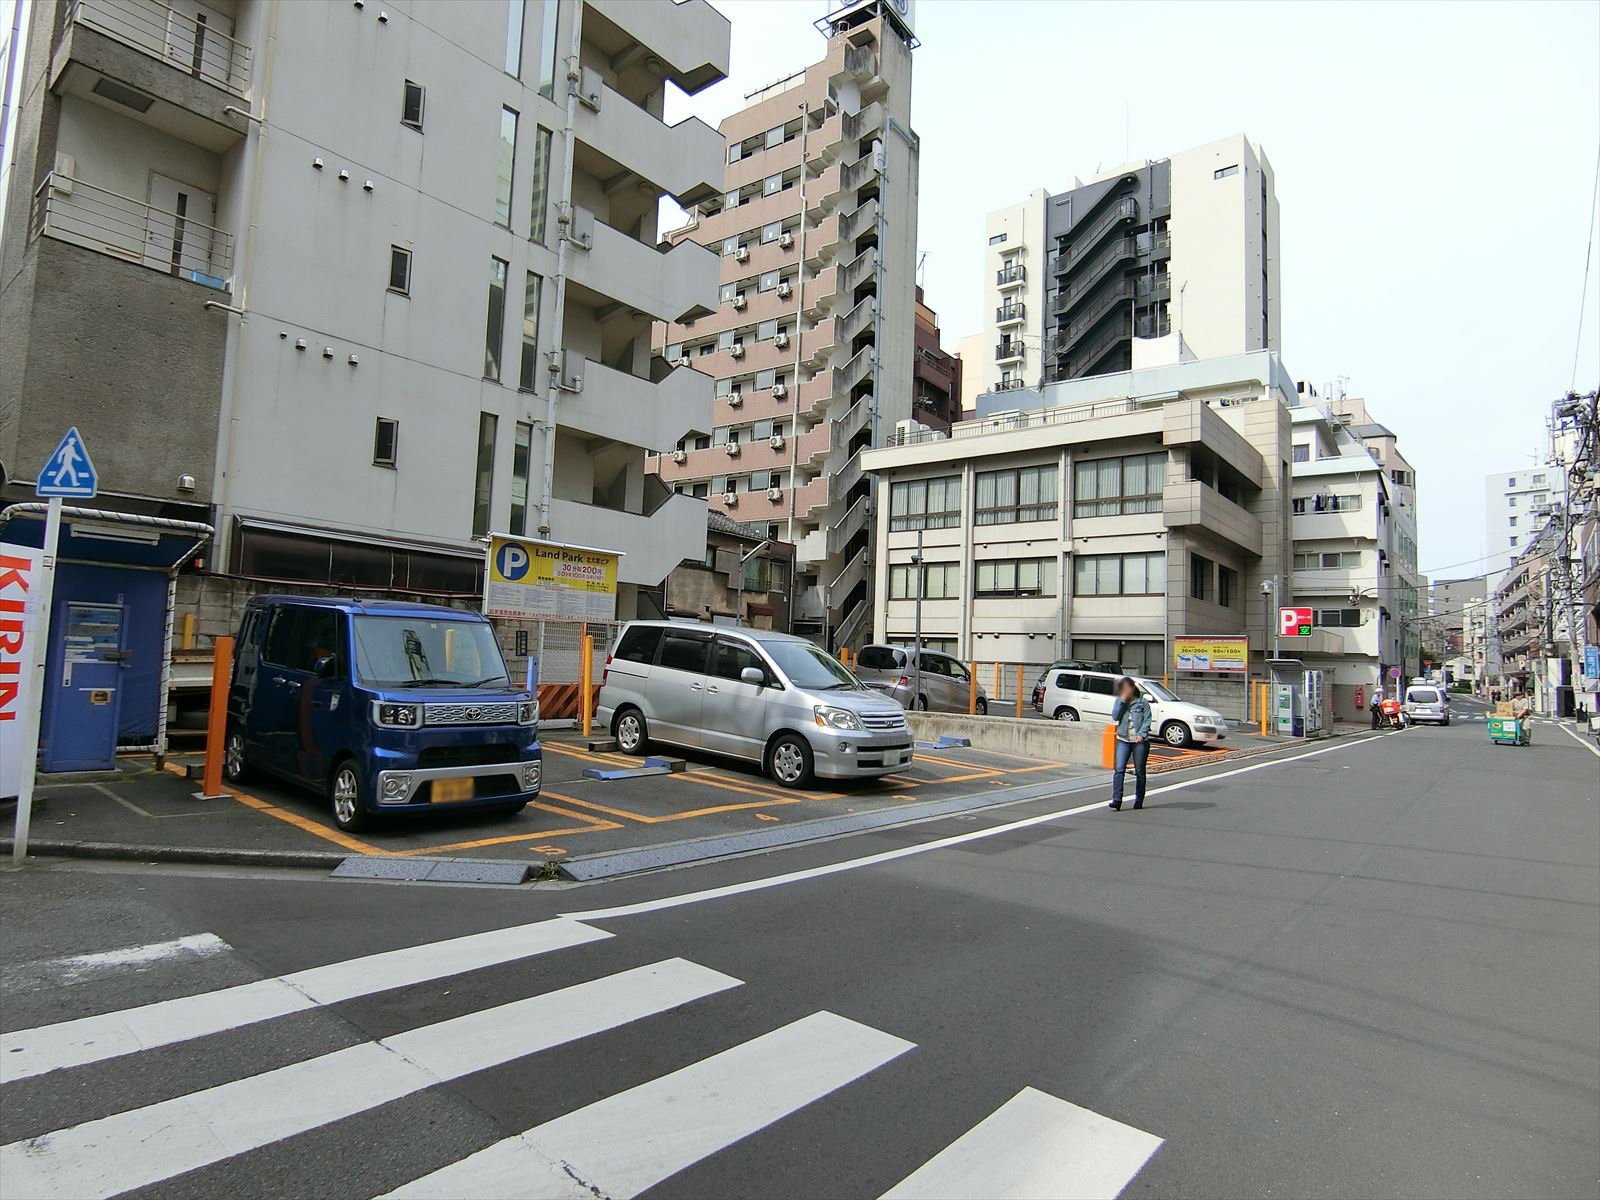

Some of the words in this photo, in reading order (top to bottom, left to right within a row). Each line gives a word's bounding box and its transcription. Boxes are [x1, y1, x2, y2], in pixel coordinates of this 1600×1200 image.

[503, 547, 527, 577] P
[535, 548, 560, 560] Land
[562, 552, 584, 563] Park
[1280, 610, 1297, 634] P
[0, 555, 32, 721] KIRIN
